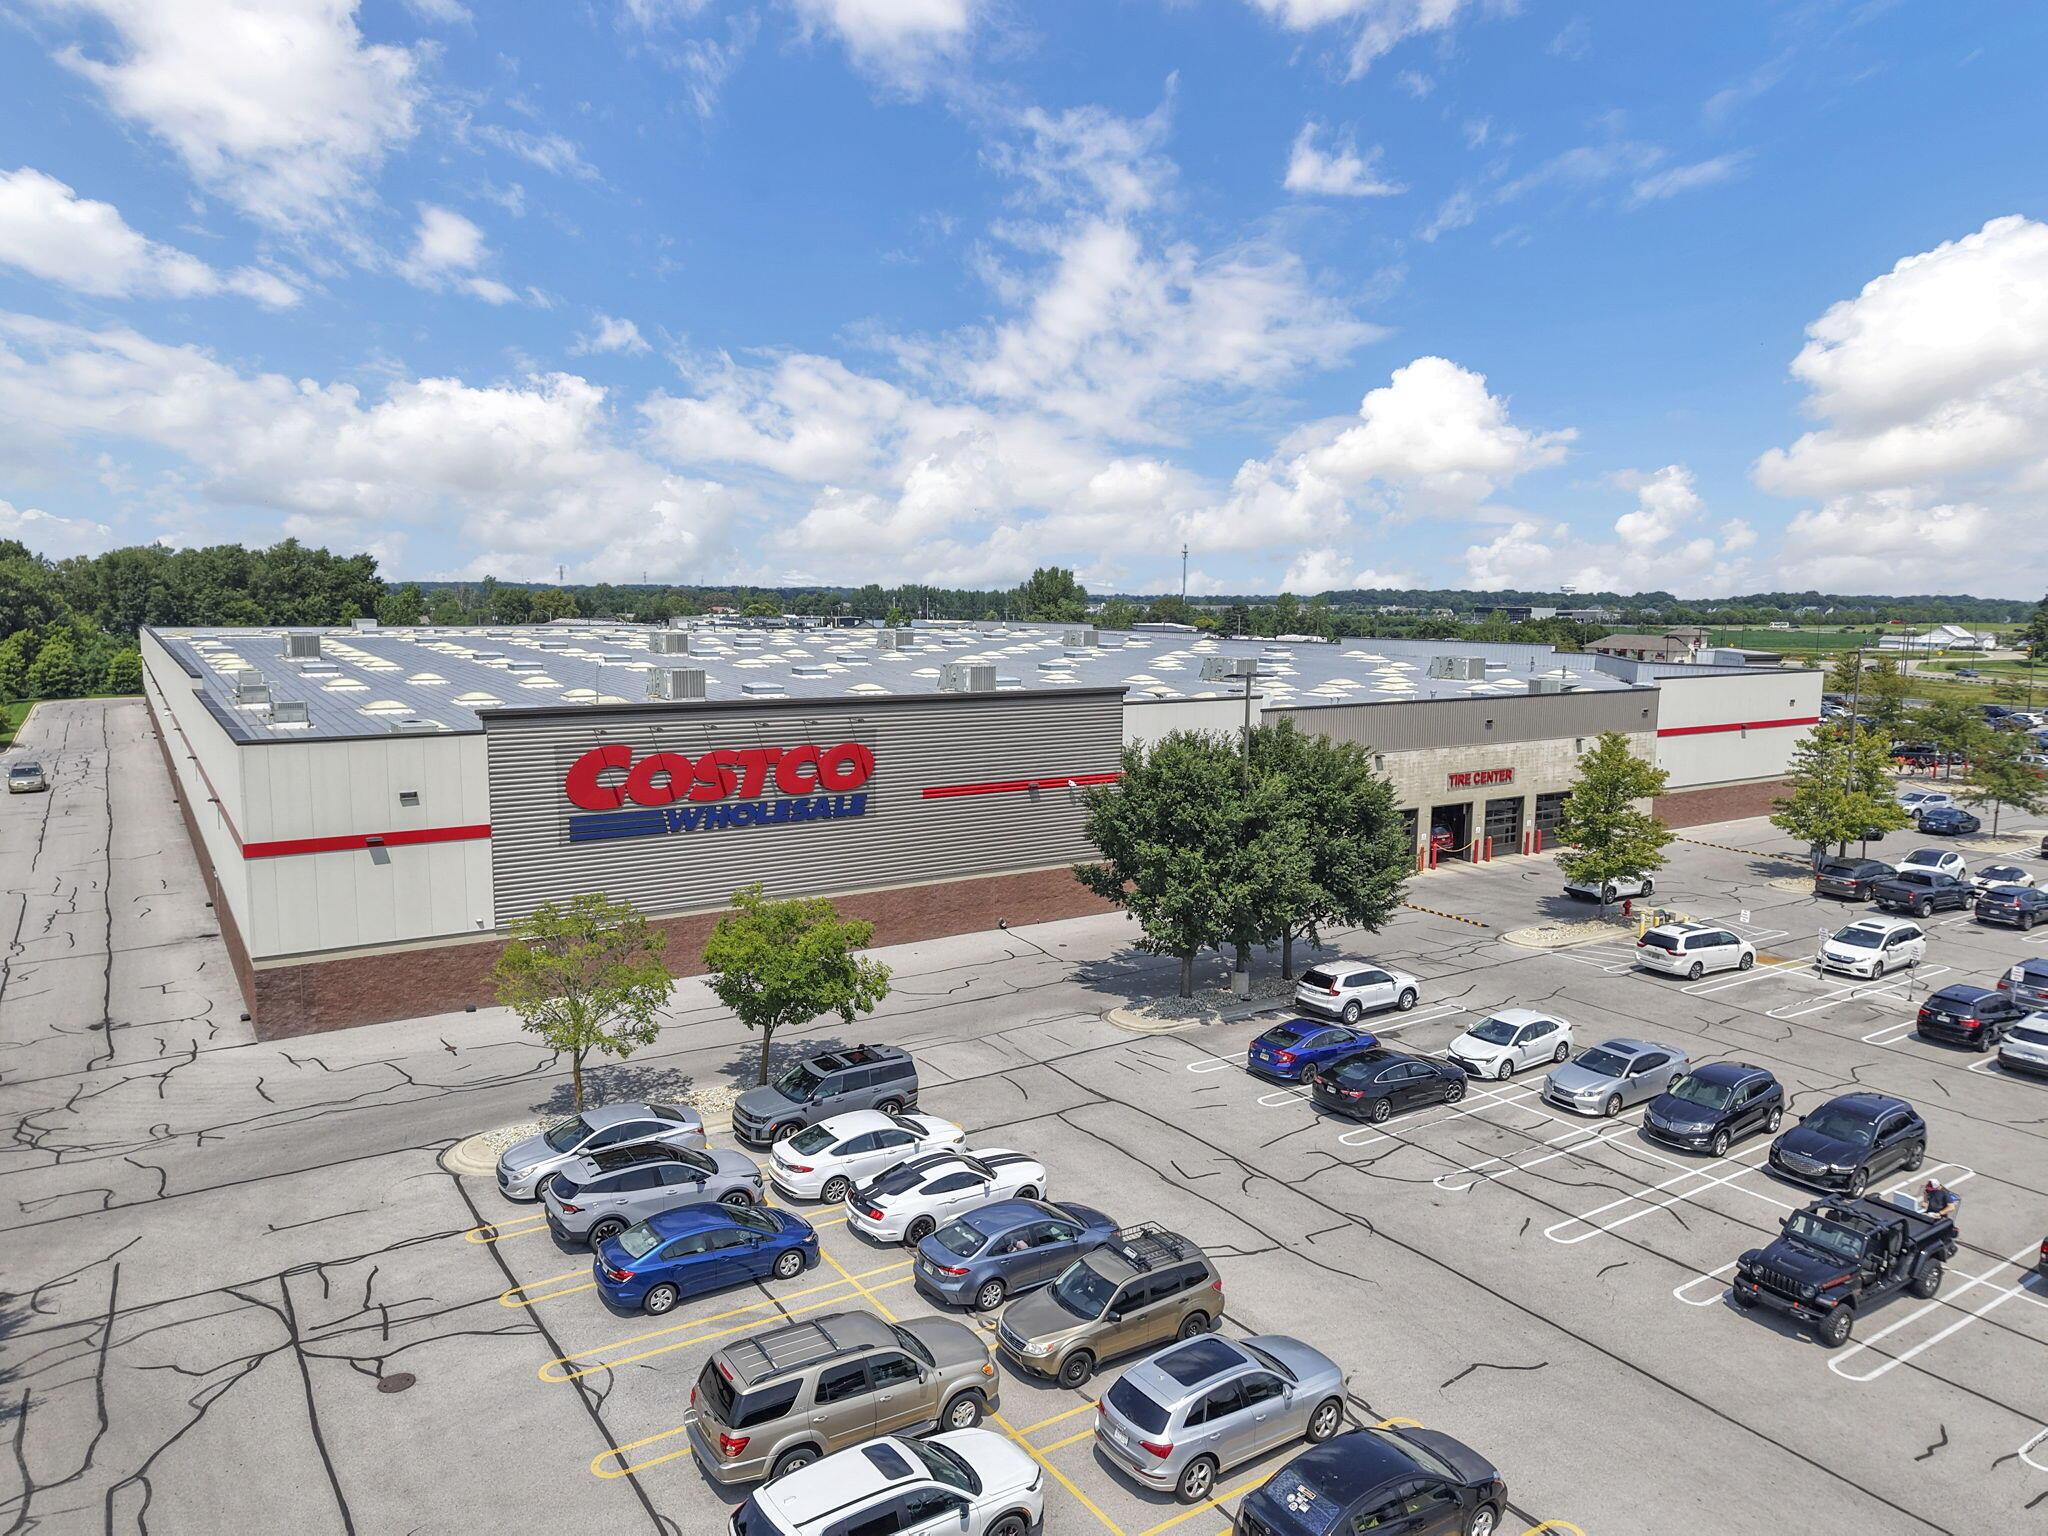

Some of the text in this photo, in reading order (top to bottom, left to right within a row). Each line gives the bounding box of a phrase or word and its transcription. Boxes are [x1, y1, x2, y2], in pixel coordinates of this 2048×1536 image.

[565, 743, 875, 810] COSTCO
[1449, 769, 1513, 788] TIRE CENTER
[666, 793, 868, 832] WHOLESALE
